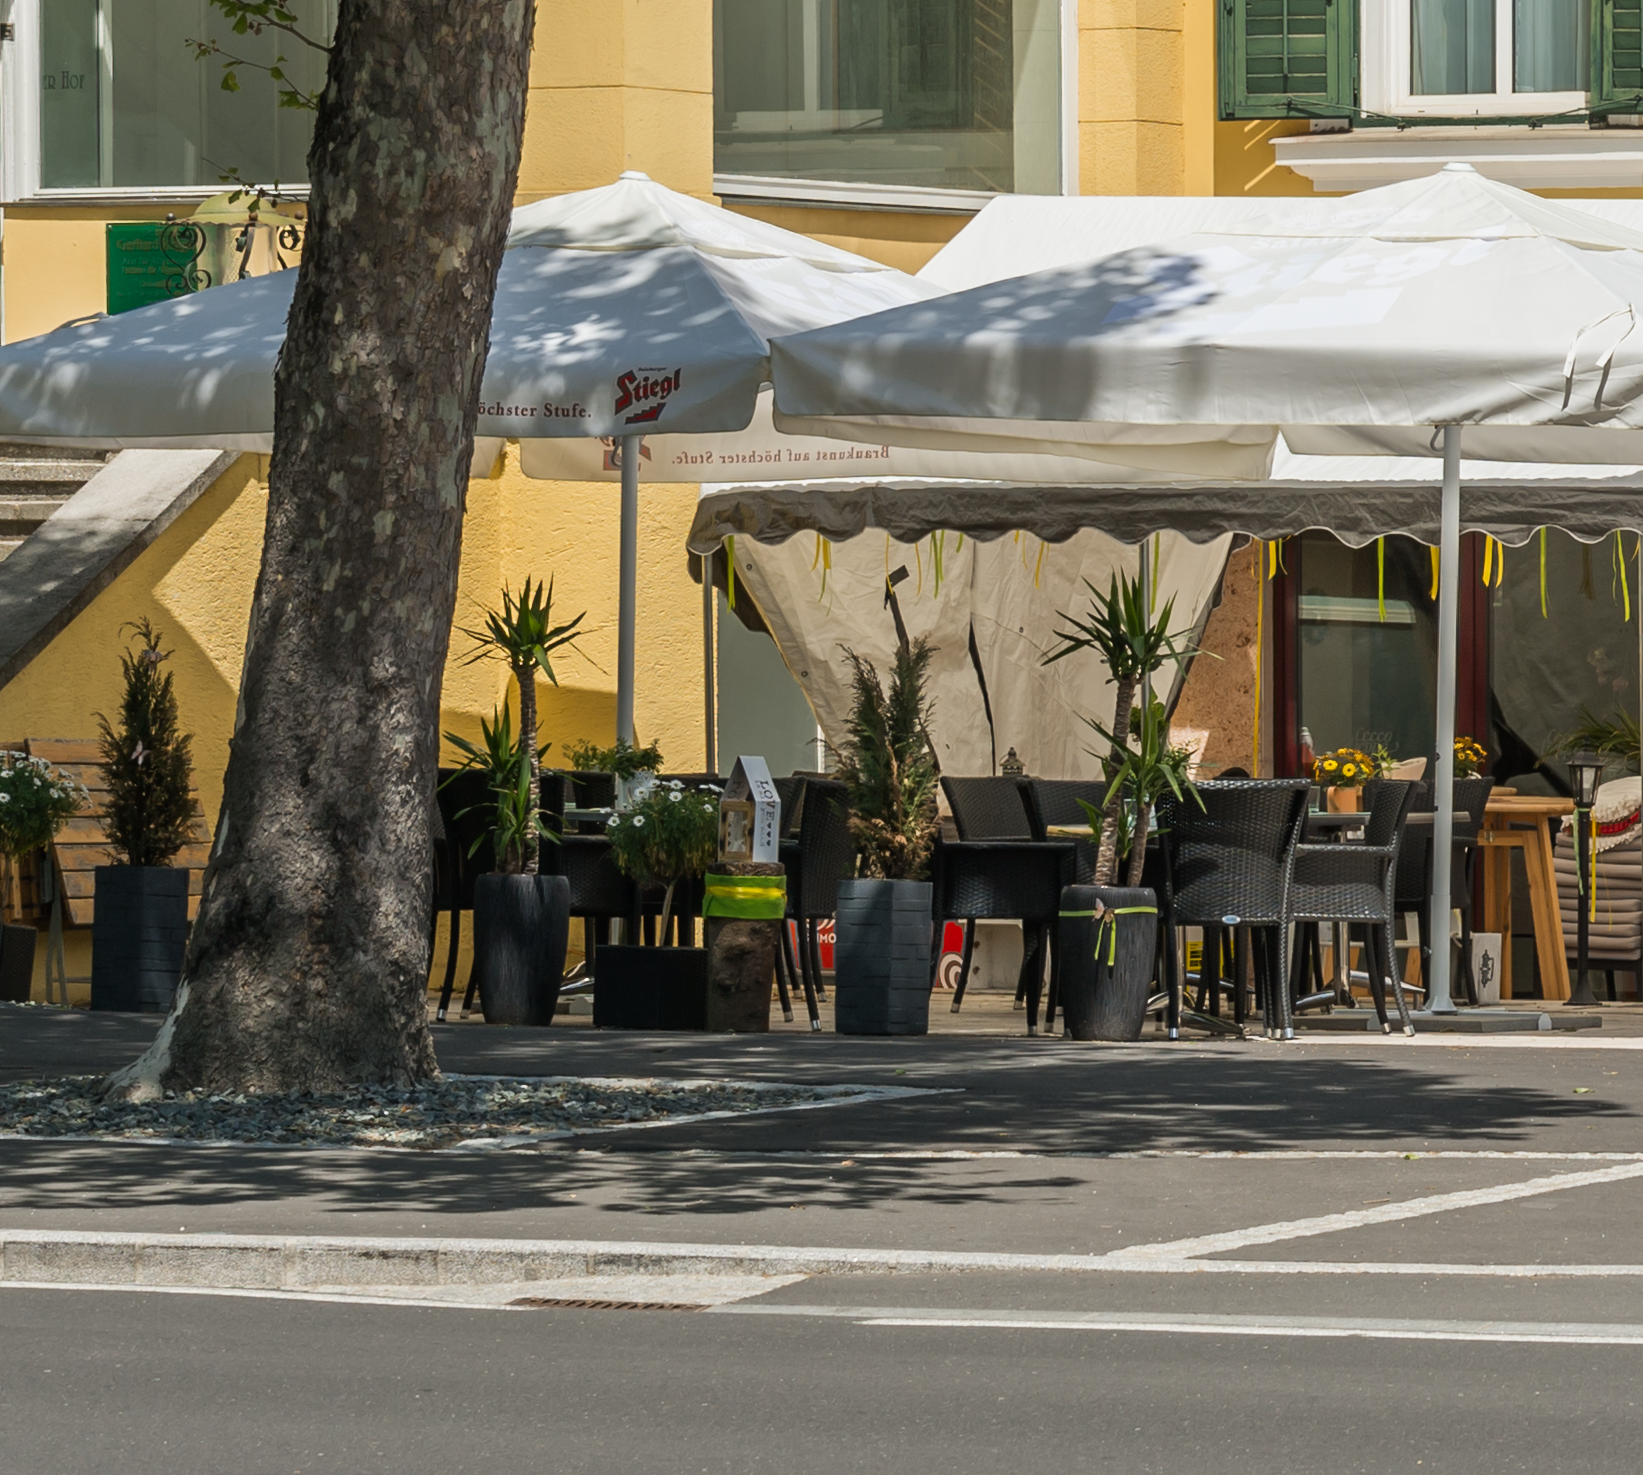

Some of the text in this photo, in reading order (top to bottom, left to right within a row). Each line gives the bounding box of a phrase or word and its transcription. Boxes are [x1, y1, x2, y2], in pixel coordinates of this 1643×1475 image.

[478, 401, 592, 418] öchster Stufe.
[614, 367, 682, 416] Stiegl
[759, 779, 776, 822] LOVE
